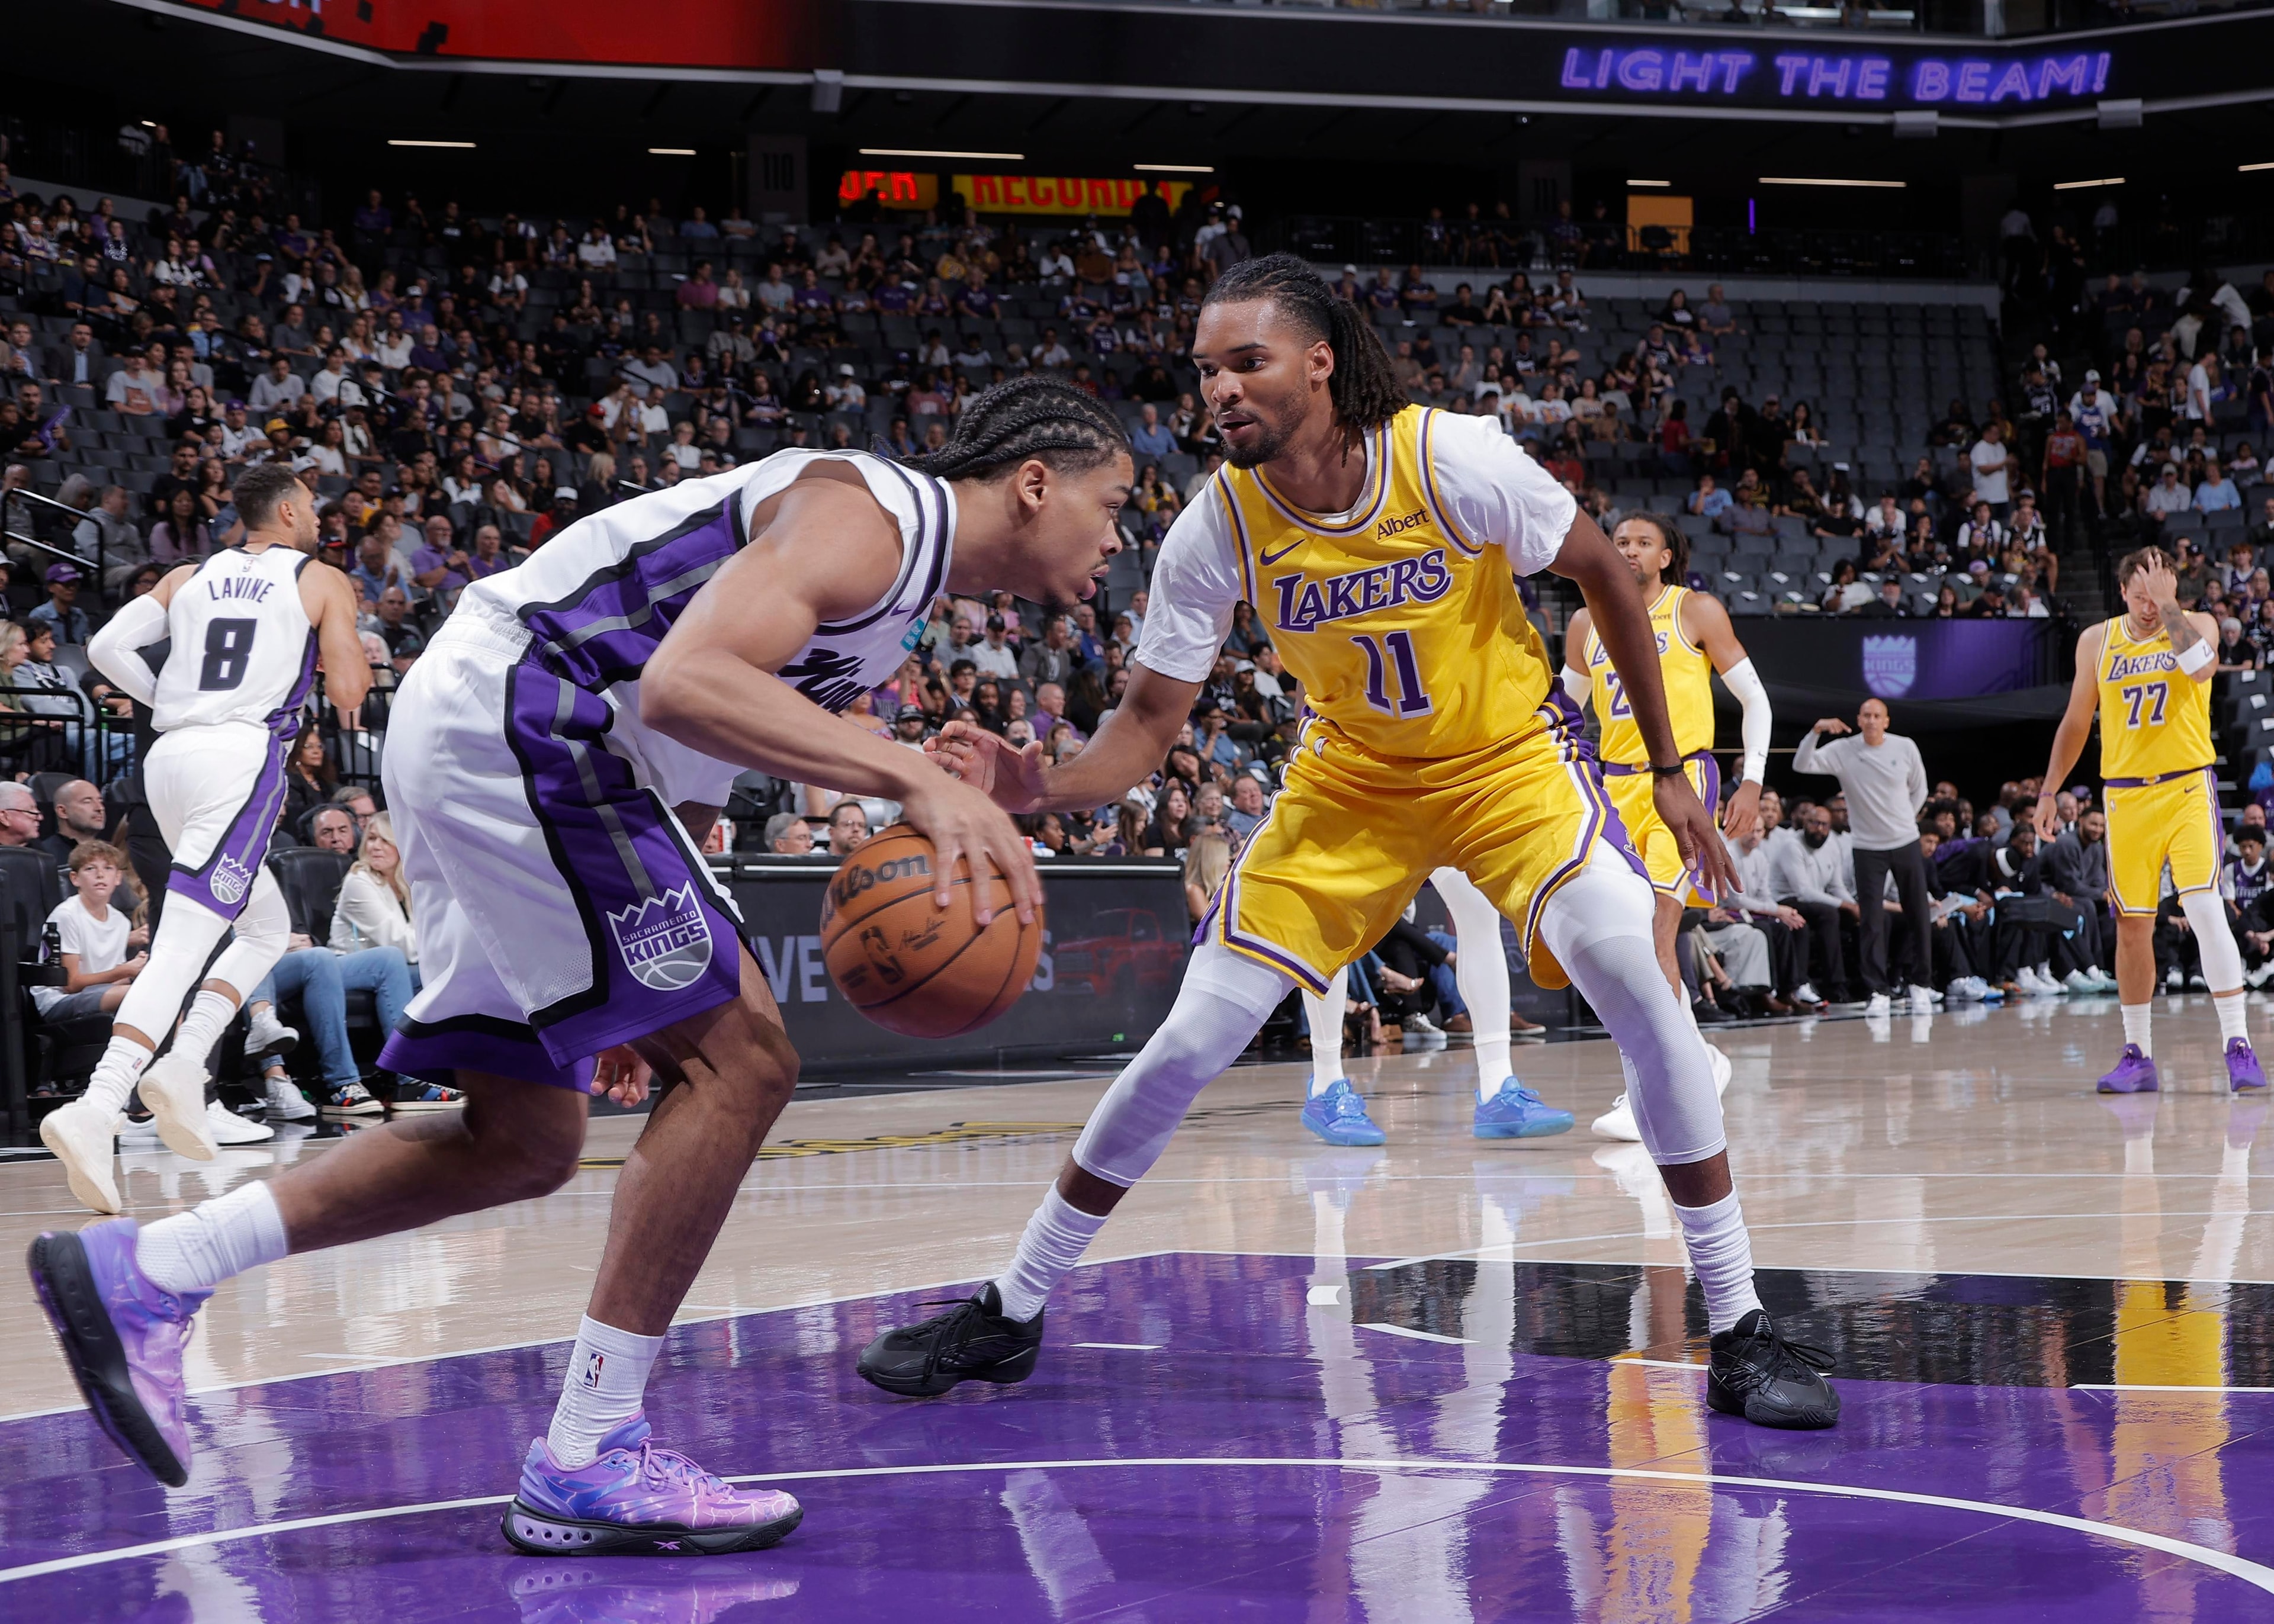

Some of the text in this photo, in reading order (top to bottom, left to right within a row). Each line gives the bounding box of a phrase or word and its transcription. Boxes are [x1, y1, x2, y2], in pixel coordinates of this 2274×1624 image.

[1561, 47, 2111, 102] LIGHT THE BEAM!
[762, 153, 794, 190] 110
[1376, 509, 1430, 541] Albert
[208, 577, 275, 603] LAVINE
[1272, 548, 1453, 633] LAKERS
[198, 617, 258, 692] 8
[1348, 629, 1434, 720] 11
[2106, 649, 2179, 683] LAKERS
[2121, 681, 2169, 729] 77
[214, 870, 243, 895] KINGS
[622, 910, 697, 944] SACRAMENTO
[624, 920, 708, 966] KINGS
